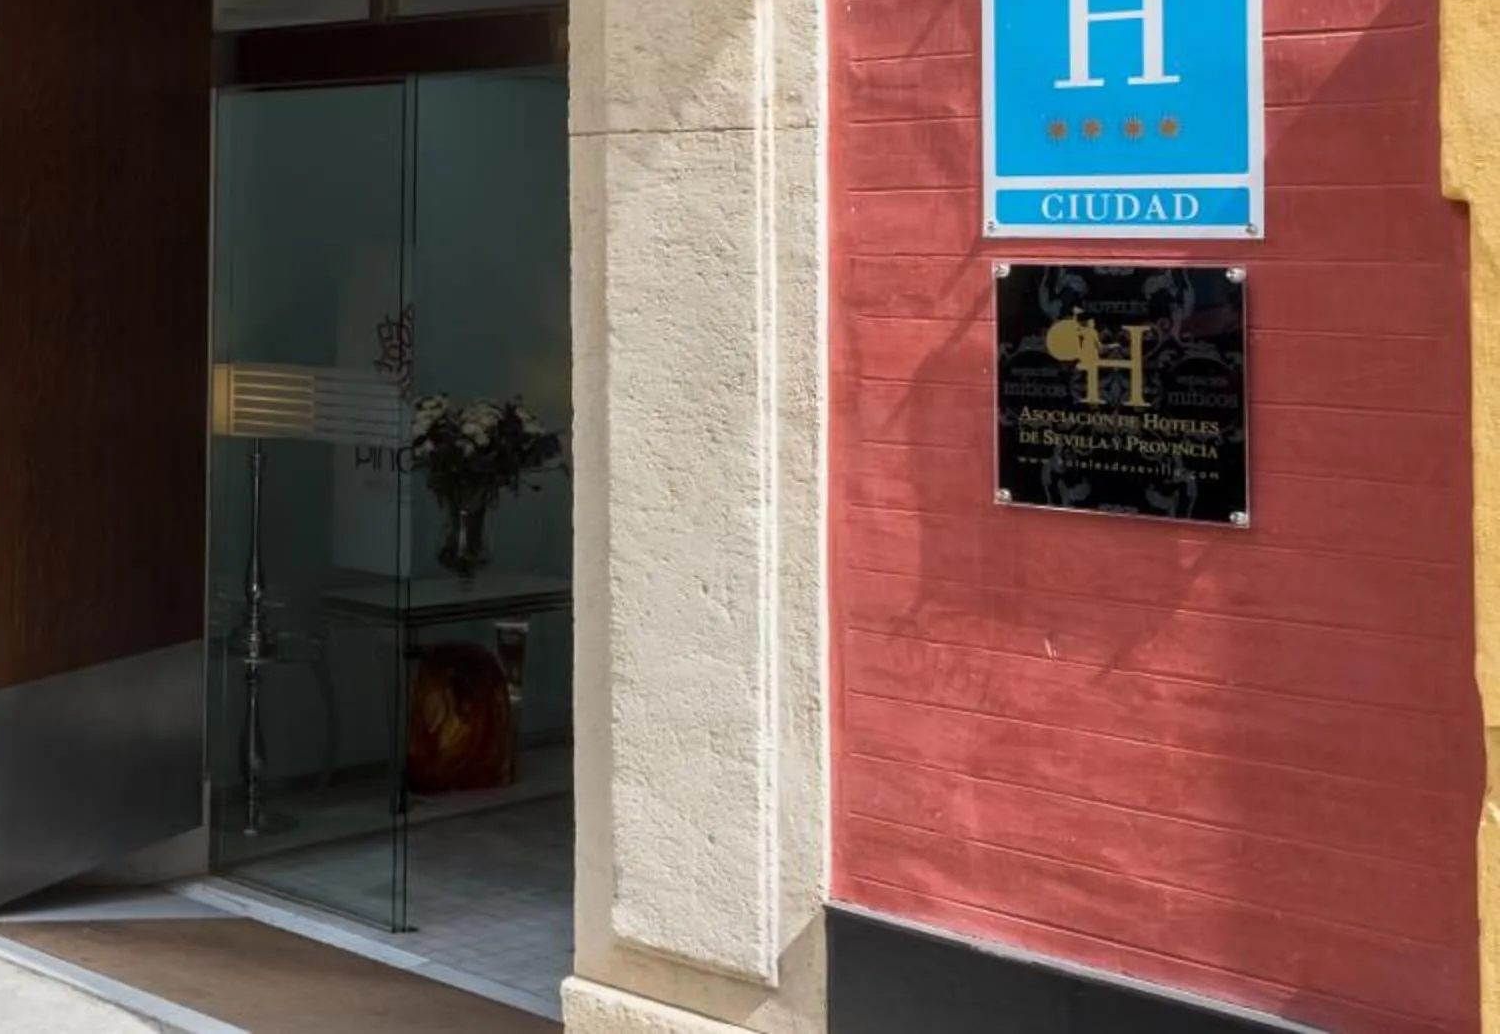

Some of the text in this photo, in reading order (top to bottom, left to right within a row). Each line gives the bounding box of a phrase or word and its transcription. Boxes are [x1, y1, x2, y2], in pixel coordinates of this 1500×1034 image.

[1041, 192, 1200, 222] CIUDAD
[1143, 413, 1220, 435] HOTELES
[1018, 430, 1040, 444] DE
[1042, 429, 1109, 450] SEVILLA
[1125, 435, 1219, 461] PROVINCIA
